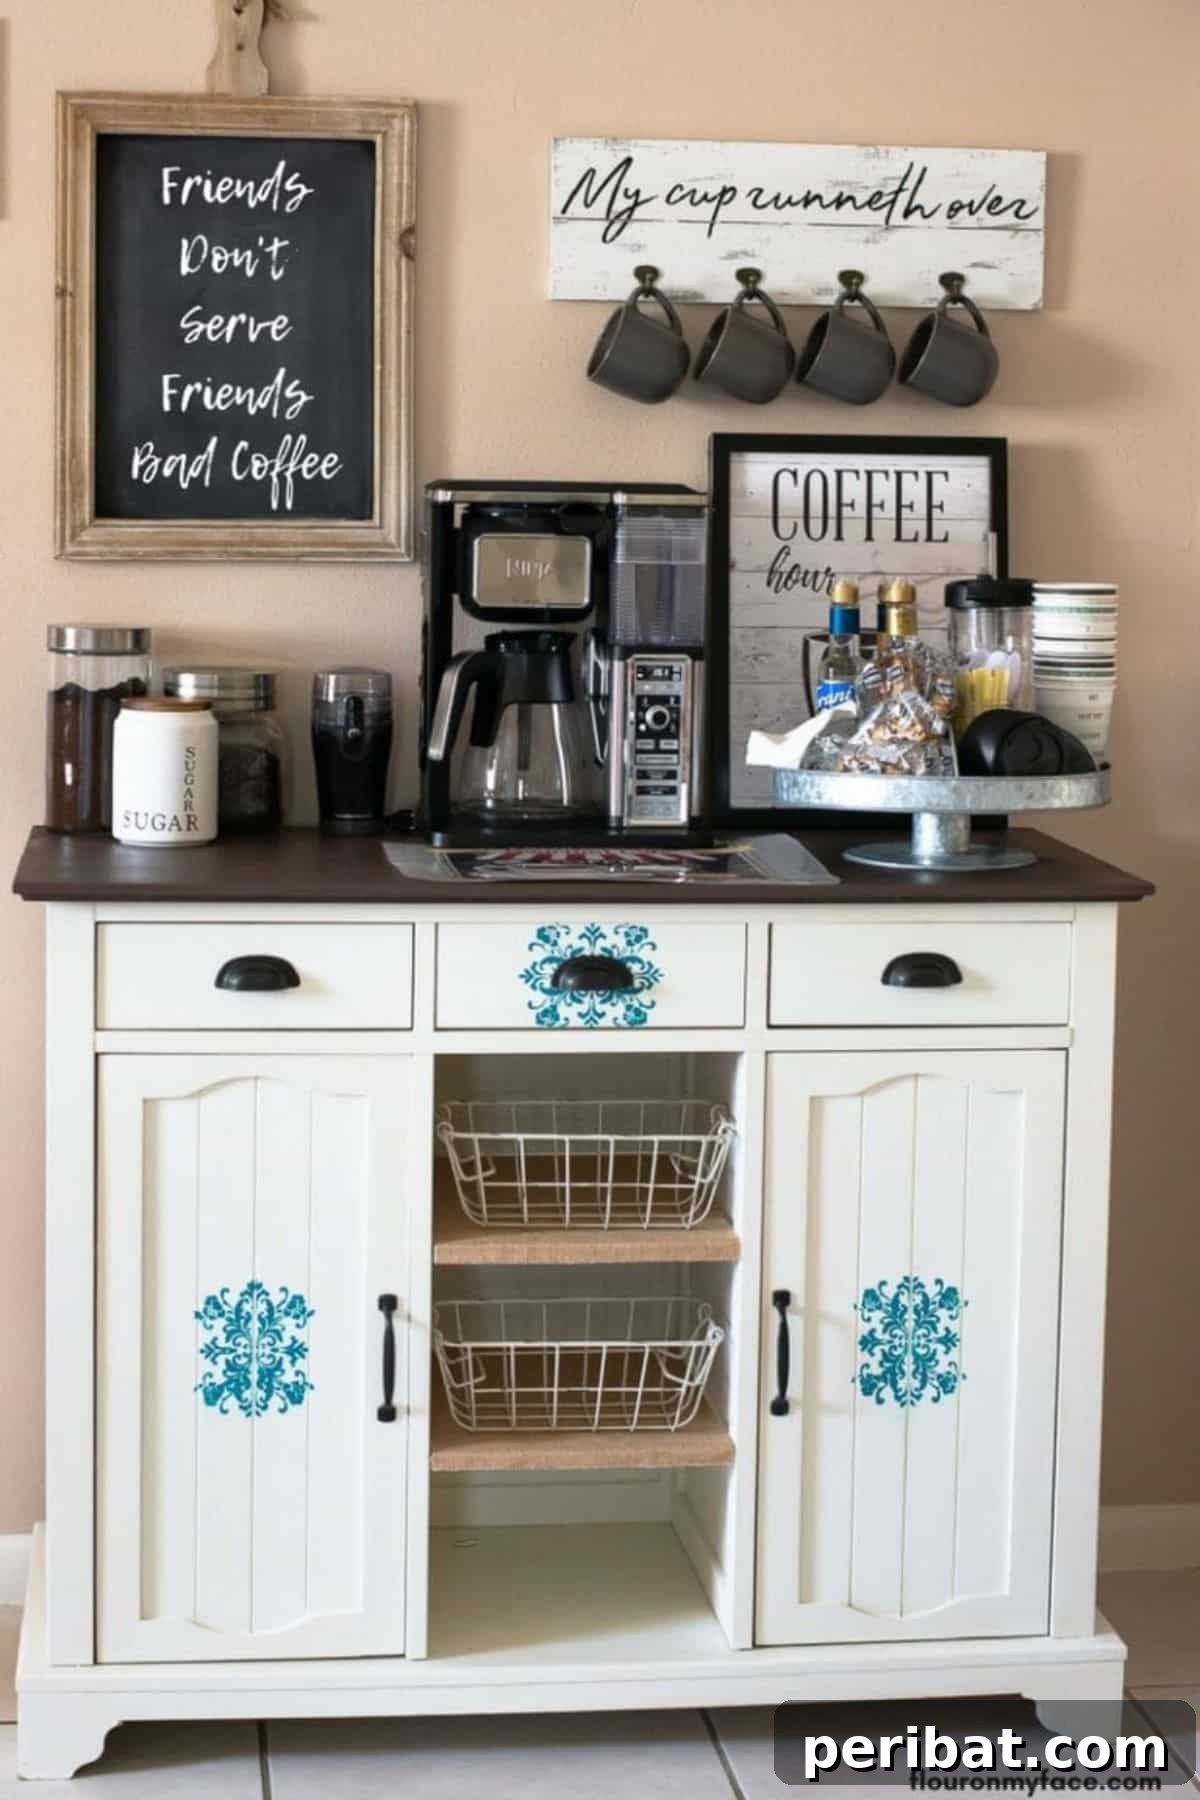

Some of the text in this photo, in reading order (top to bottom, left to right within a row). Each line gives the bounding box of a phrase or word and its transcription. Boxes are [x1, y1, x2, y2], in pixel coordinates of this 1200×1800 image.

[162, 160, 313, 212] Friends
[561, 156, 1039, 244] My cup runneth over
[179, 234, 290, 281] Don't
[180, 305, 293, 344] Serve
[162, 367, 313, 420] Friends
[131, 434, 343, 510] Bad Coffee
[771, 467, 950, 543] COFFEE
[766, 544, 836, 597] hour
[184, 745, 197, 812] SUGAR
[123, 810, 200, 832] SUGAR
